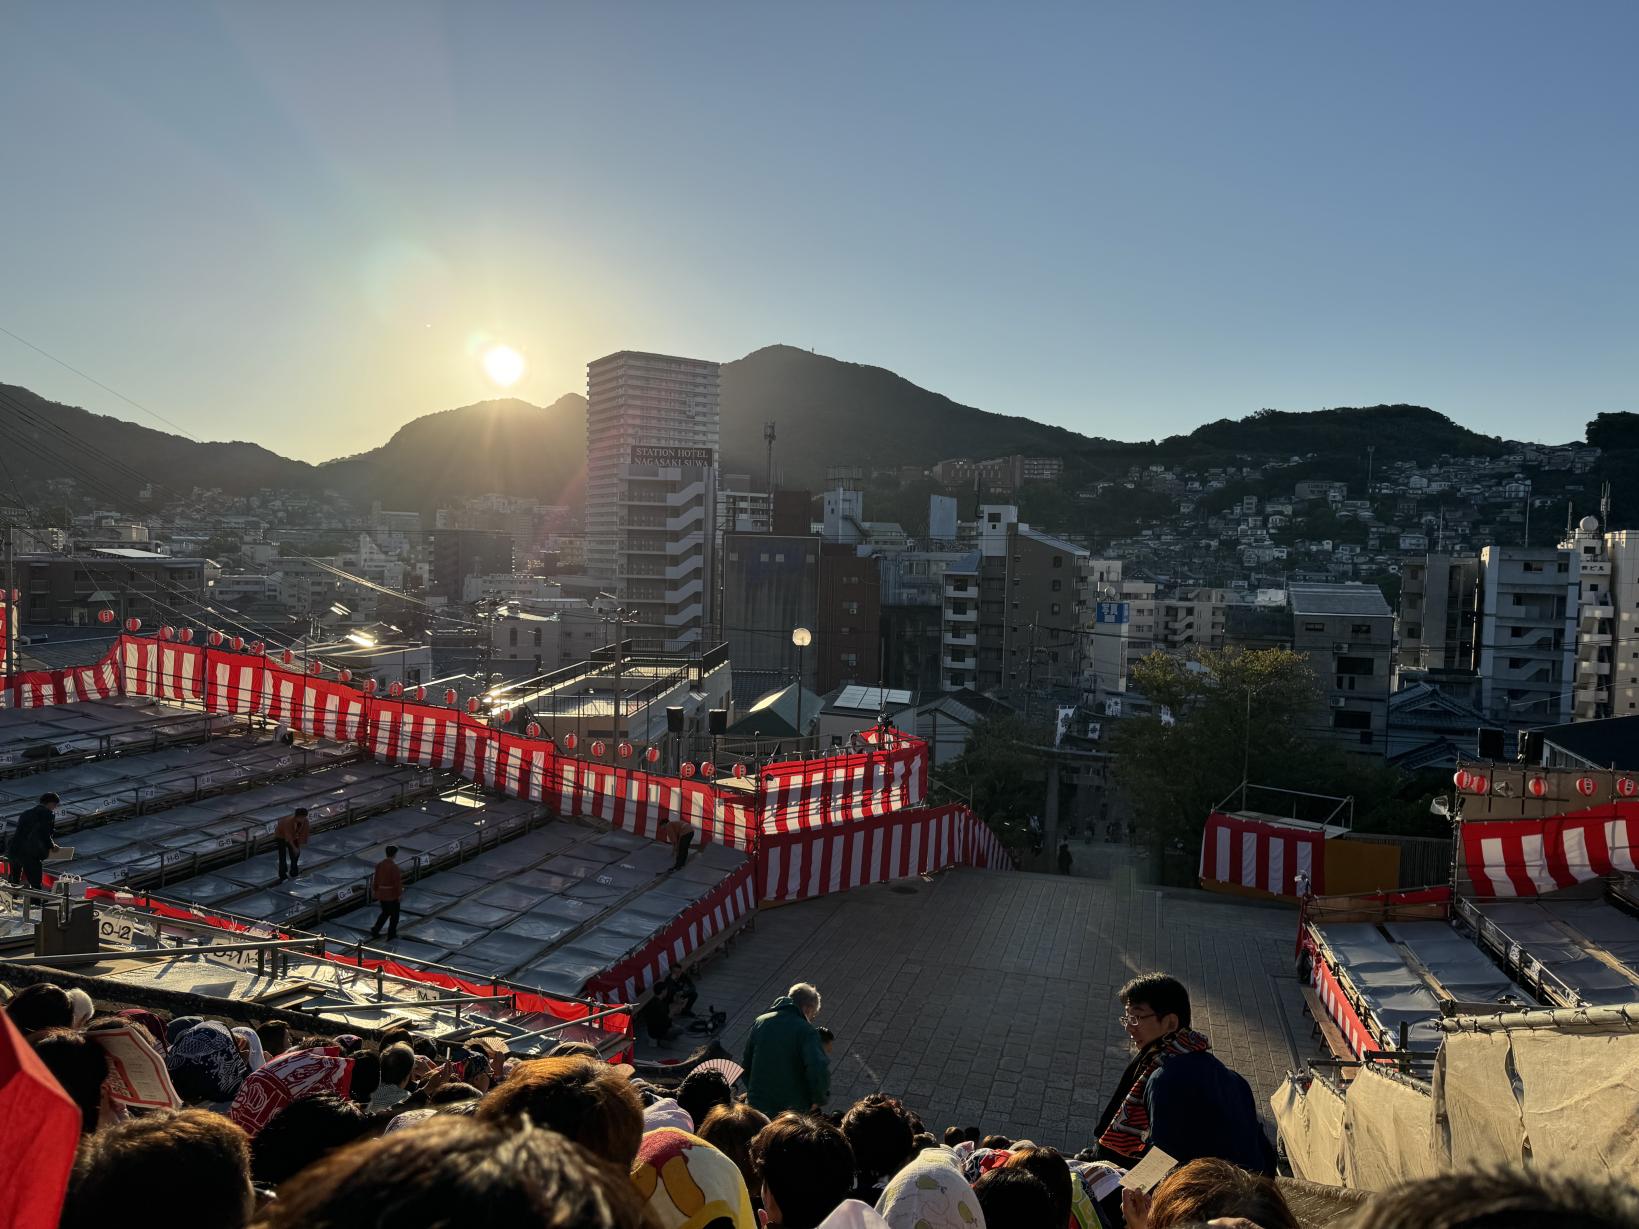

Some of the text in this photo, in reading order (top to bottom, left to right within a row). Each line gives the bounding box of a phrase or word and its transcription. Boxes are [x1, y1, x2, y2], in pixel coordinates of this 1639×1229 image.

[636, 447, 708, 458] STATION HOTEL
[102, 922, 131, 940] O-2
